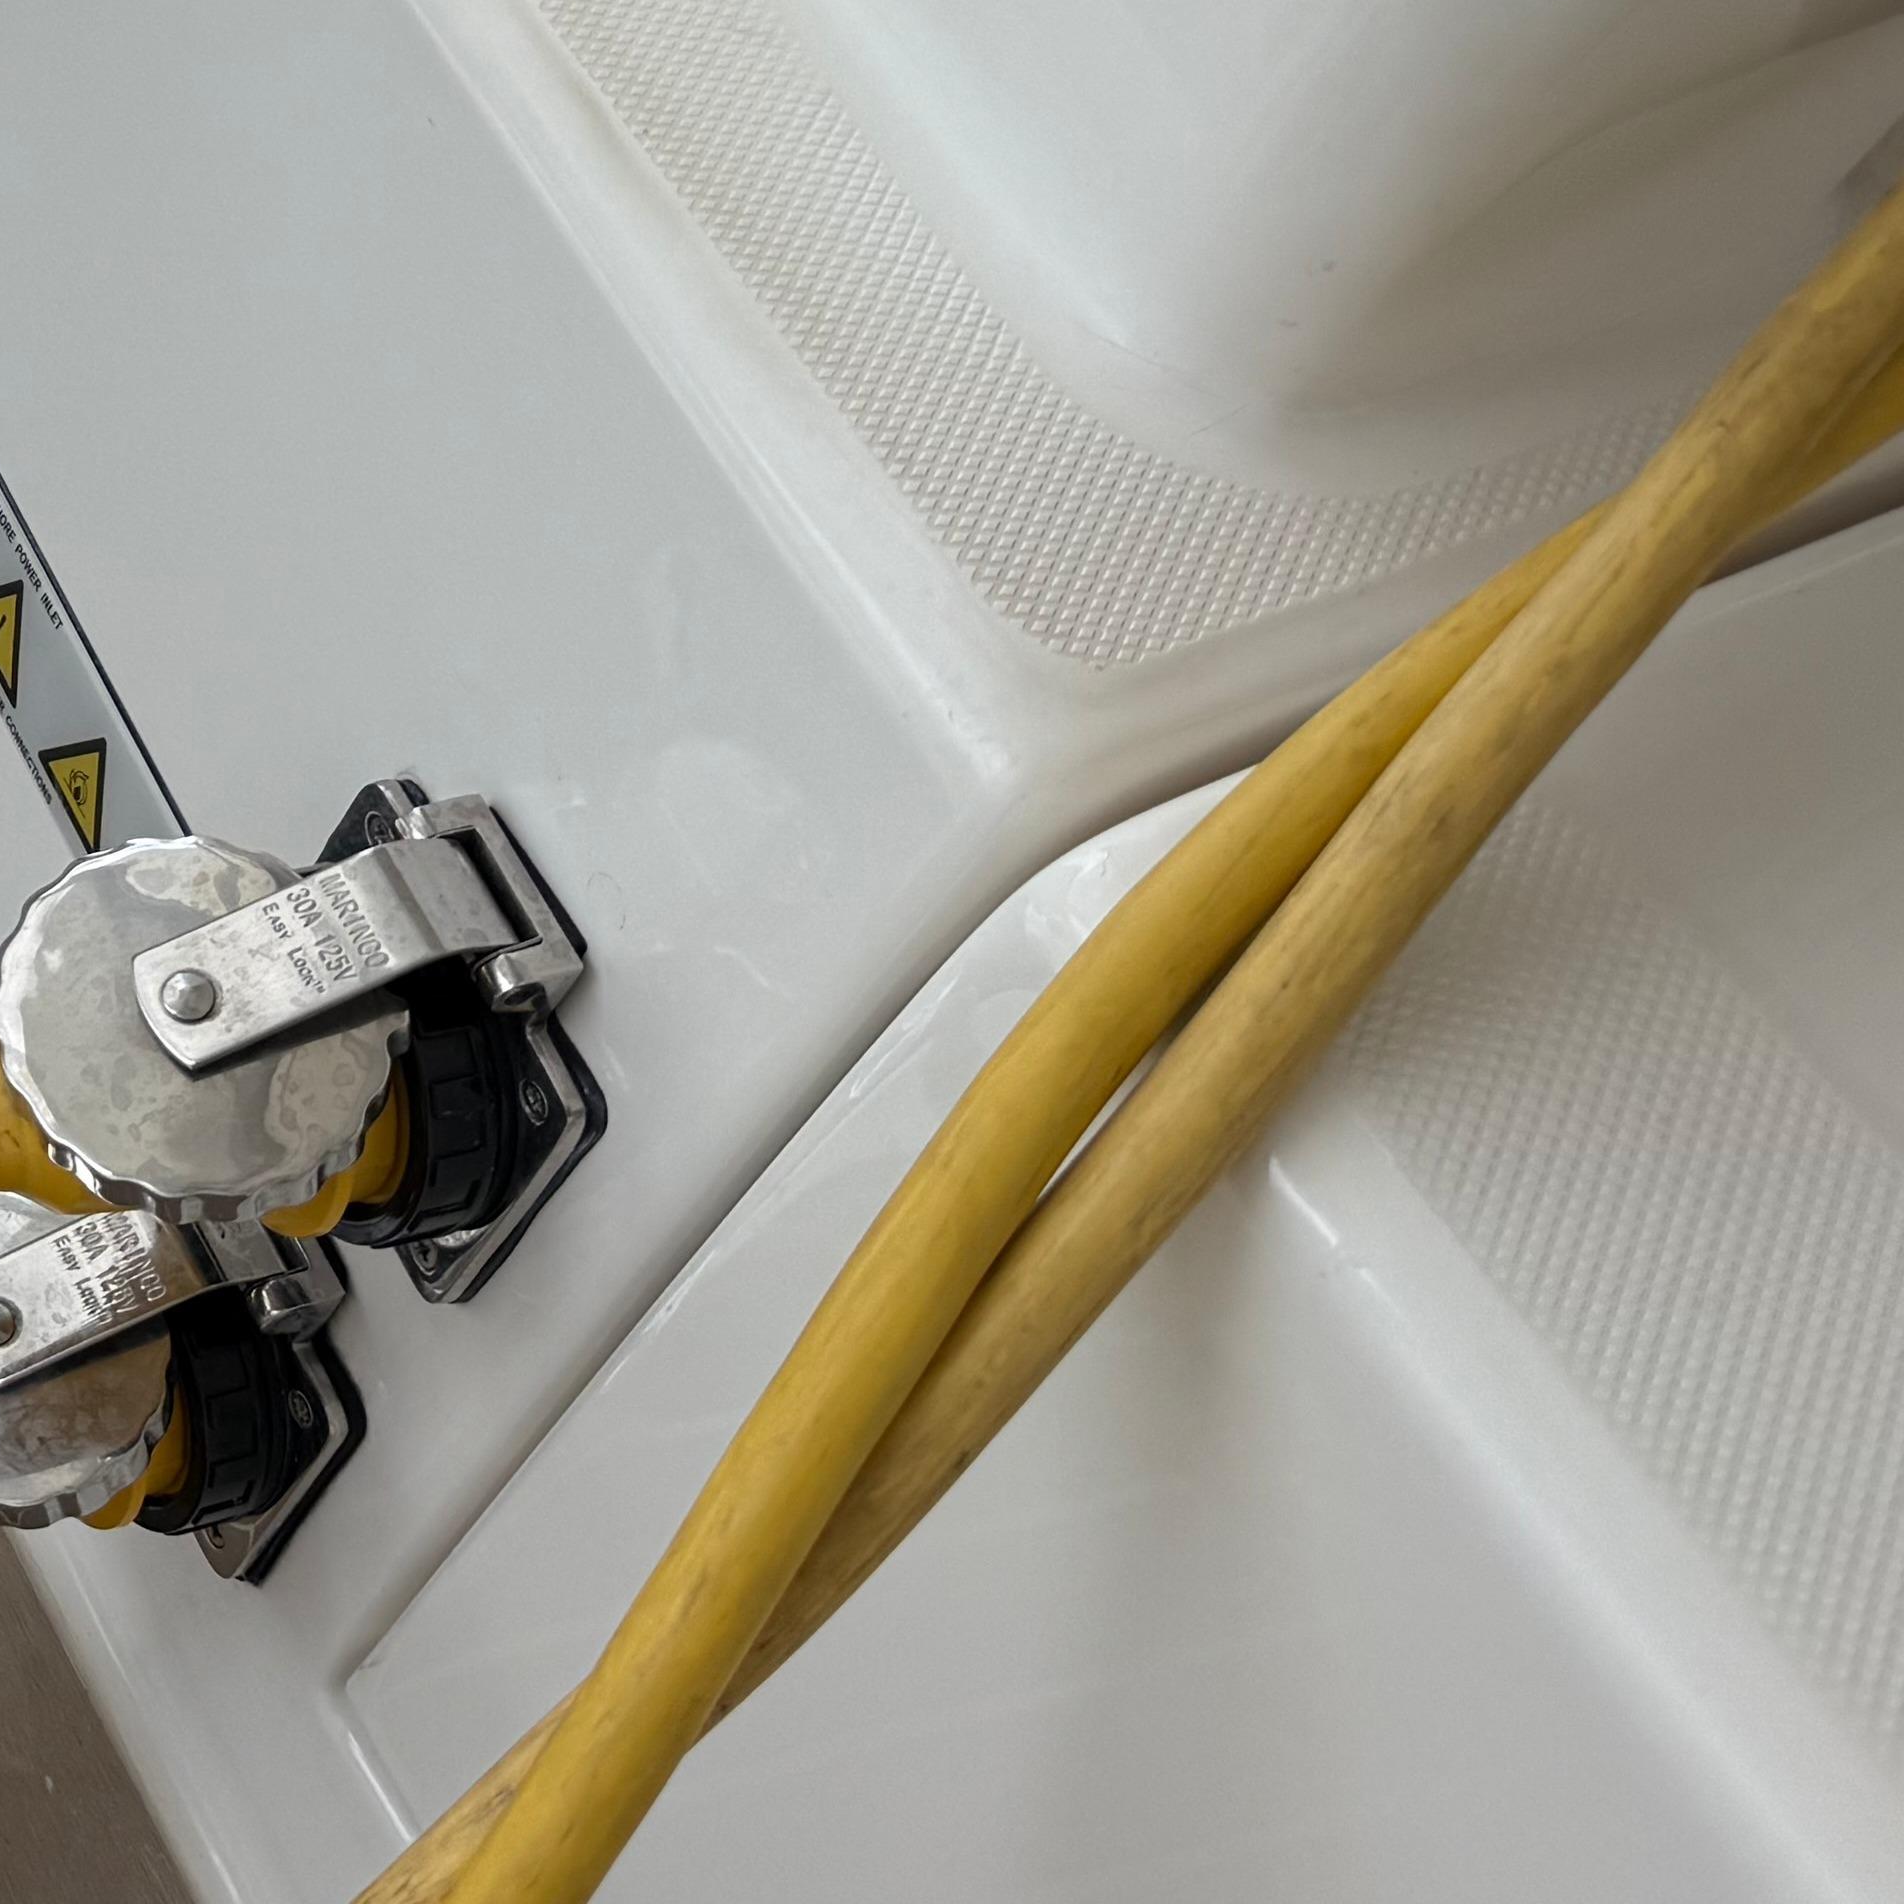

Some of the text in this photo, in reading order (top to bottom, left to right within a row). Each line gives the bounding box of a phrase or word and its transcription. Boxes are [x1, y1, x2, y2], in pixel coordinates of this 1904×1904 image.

[15, 543, 42, 593] POWER
[40, 593, 64, 630] INLET
[6, 715, 53, 805] CONNECTIONS
[287, 887, 358, 982] 30A 125V
[319, 872, 390, 968] MARINCO
[71, 1221, 110, 1265] 30A
